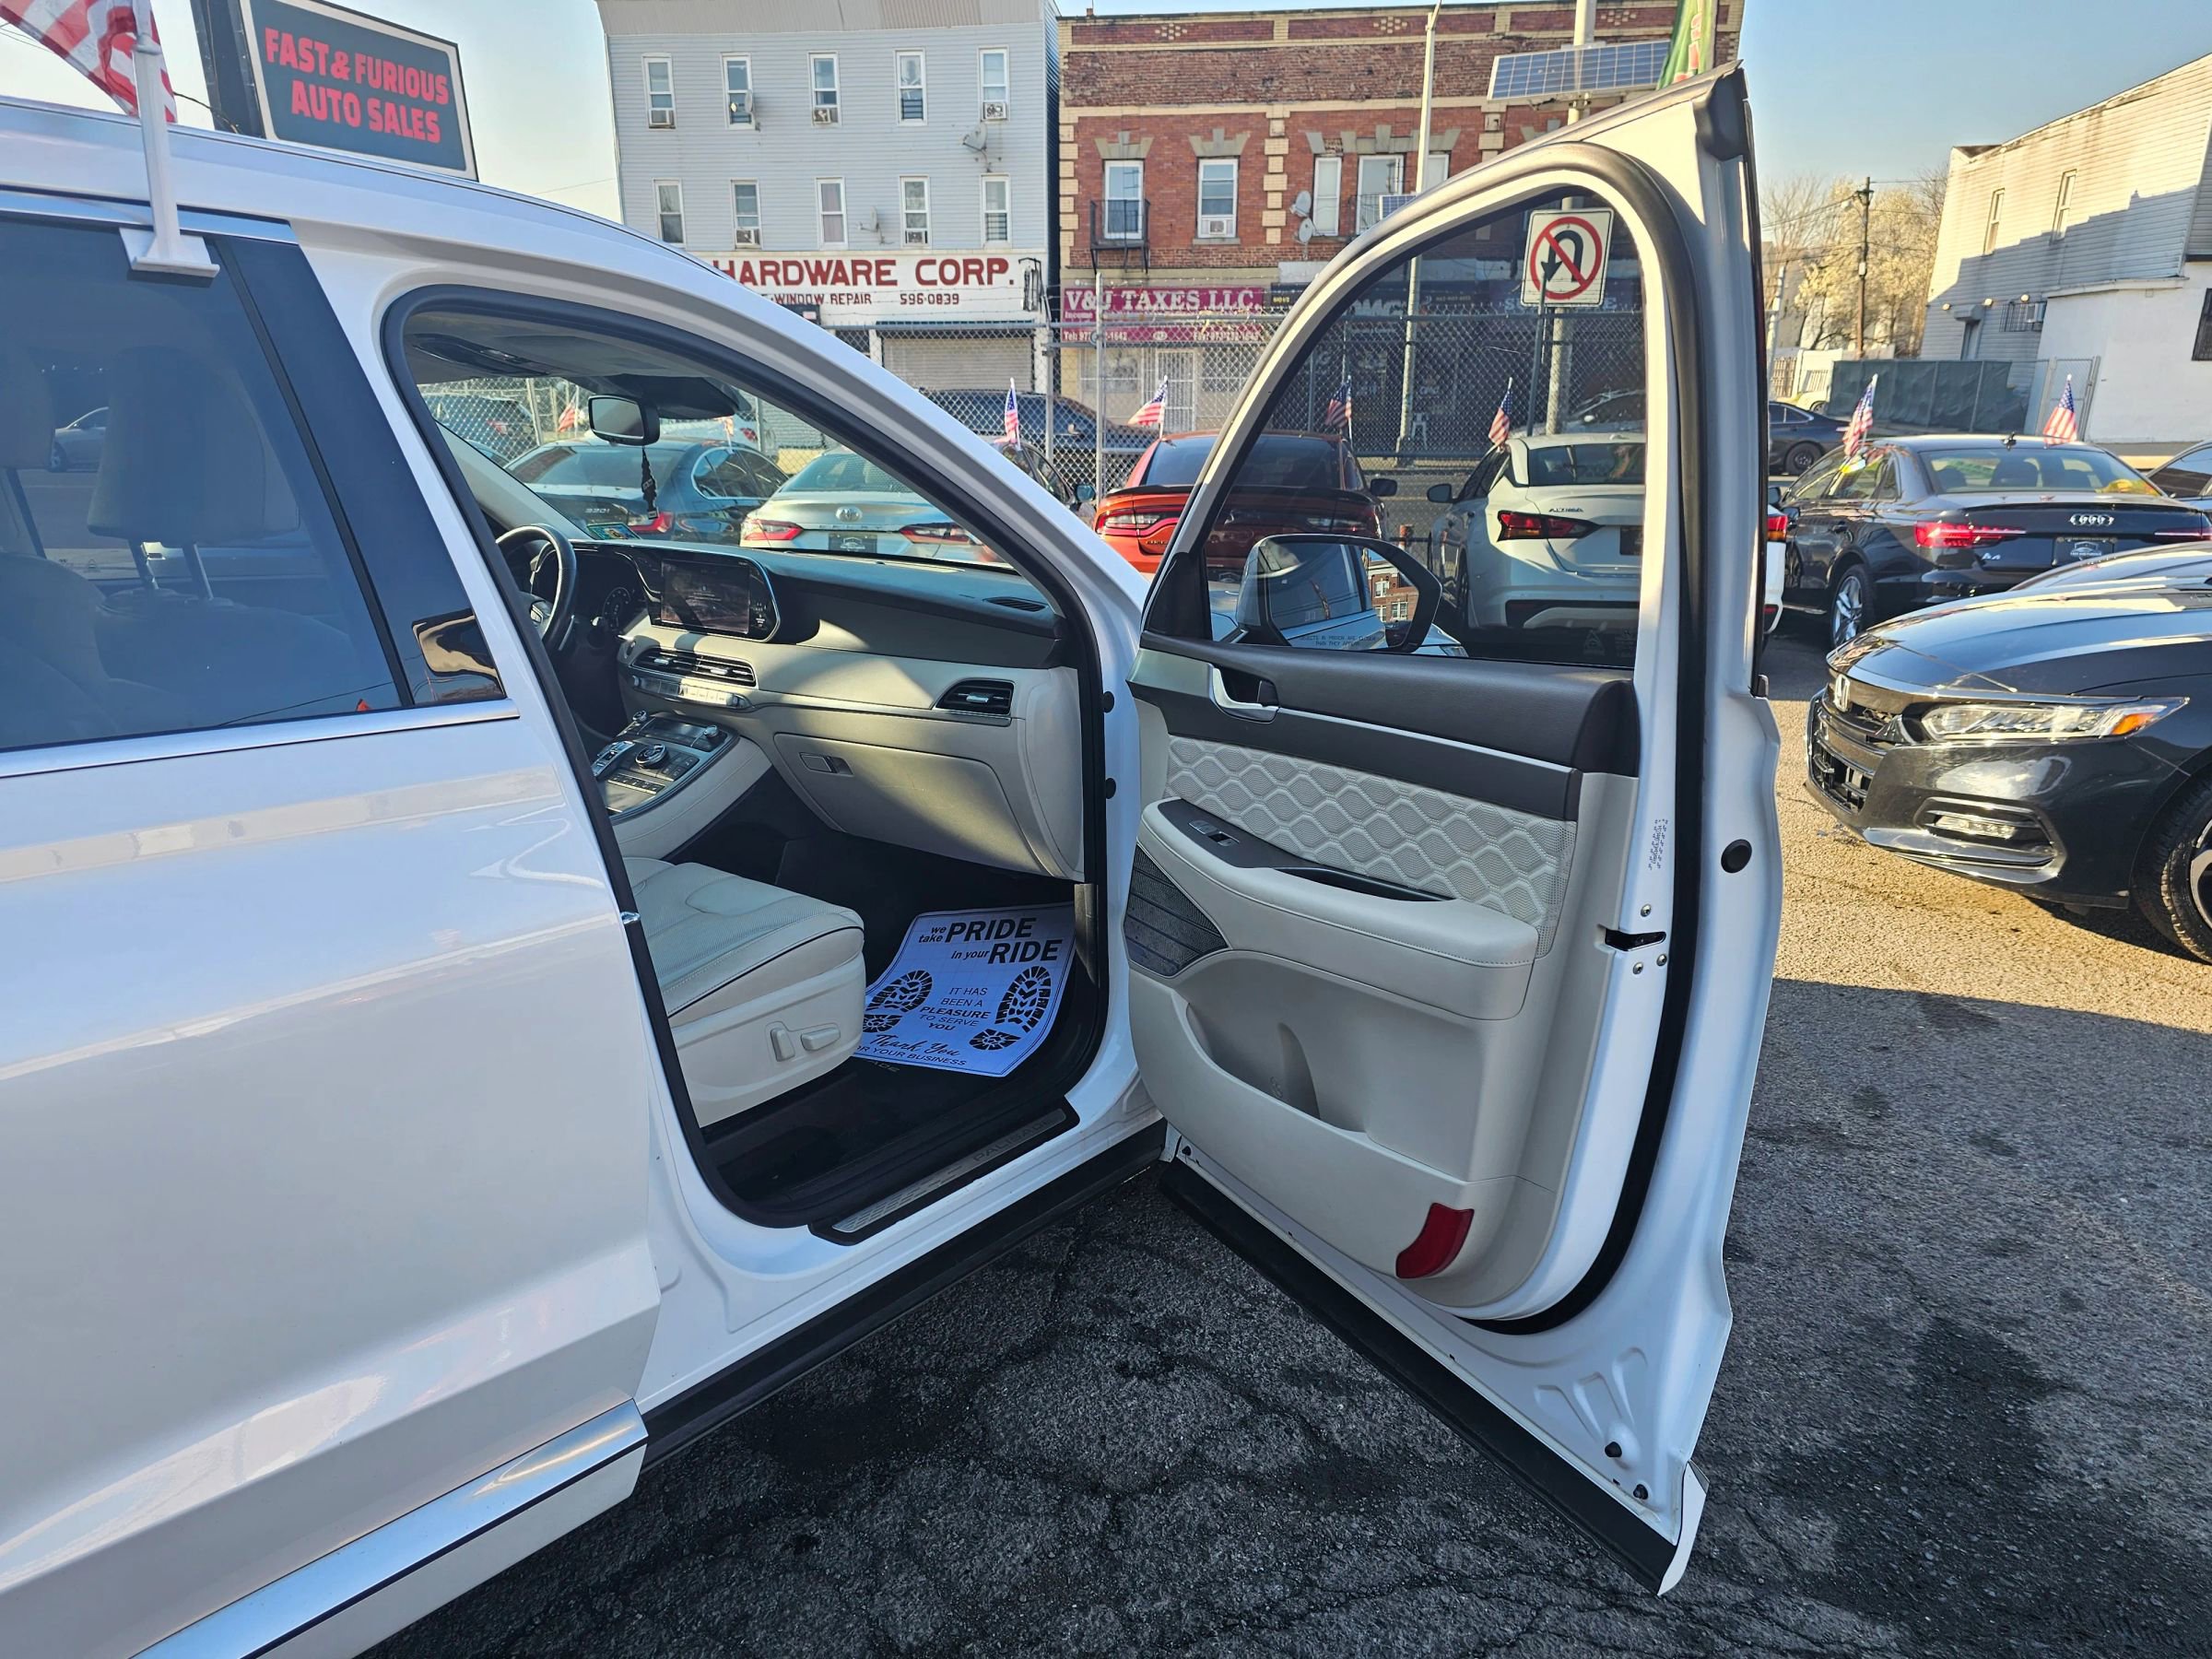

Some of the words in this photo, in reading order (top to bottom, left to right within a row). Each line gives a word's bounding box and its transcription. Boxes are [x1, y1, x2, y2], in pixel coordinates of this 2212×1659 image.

[264, 27, 329, 76] FAST
[330, 51, 351, 81] &
[355, 53, 449, 105] FURIOUS
[290, 79, 361, 128] AUTO
[367, 98, 441, 144] SALES
[712, 258, 898, 287] HARDWARE
[915, 257, 1015, 287] CORP.
[830, 292, 872, 306] REPAIR
[1120, 289, 1201, 311] TAXES
[918, 935, 944, 943] take
[945, 917, 1037, 943] PRIDE
[931, 925, 947, 934] we
[951, 950, 962, 959] in
[963, 950, 991, 960] your
[987, 938, 1063, 964] RIDE
[948, 987, 962, 995] IT
[963, 987, 988, 995] HAS
[940, 997, 973, 1006] BEEN
[920, 1006, 992, 1018] PLEASURE
[938, 1017, 980, 1027] SERVE
[928, 1022, 956, 1030] YOU
[869, 1033, 928, 1052] Thank
[924, 1041, 960, 1056] You
[873, 1047, 906, 1057] YOUR
[907, 1053, 967, 1065] BUSINESS
[972, 1120, 1053, 1162] PALISADE
